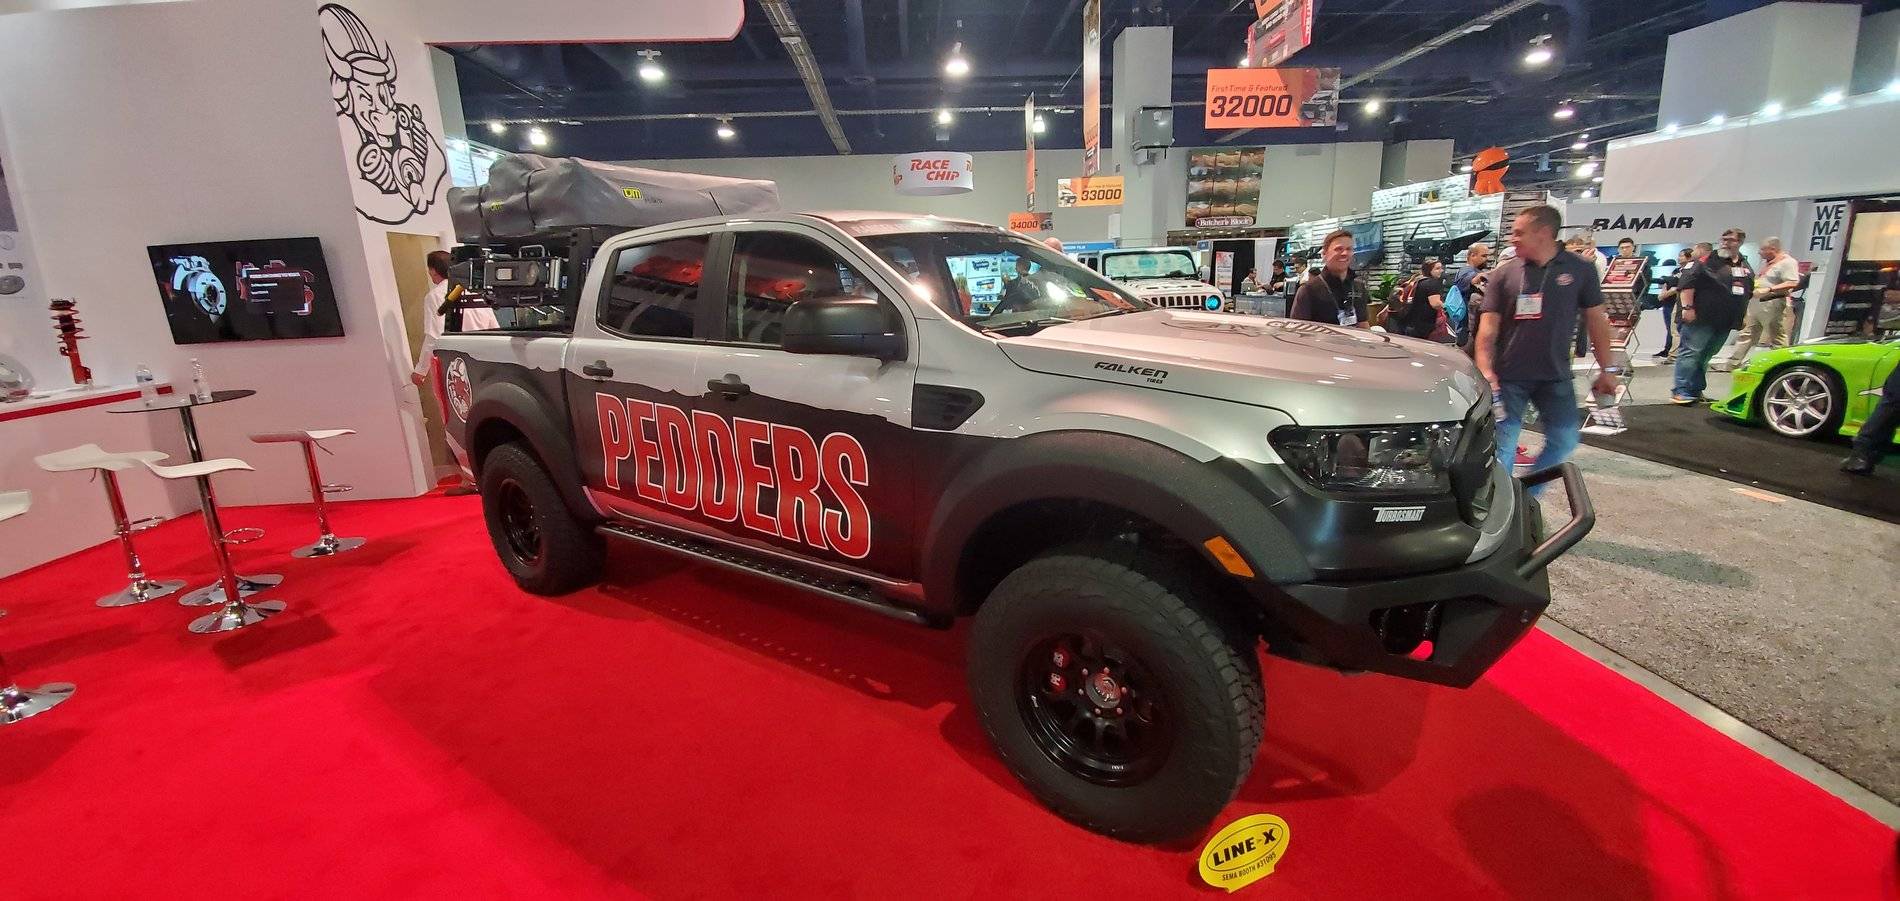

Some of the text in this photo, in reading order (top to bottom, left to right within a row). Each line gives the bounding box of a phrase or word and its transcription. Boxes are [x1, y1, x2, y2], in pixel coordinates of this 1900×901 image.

[1210, 95, 1293, 117] 32000
[911, 159, 950, 171] RACE
[926, 171, 959, 181] CHIP
[1081, 189, 1122, 201] 33000
[1816, 204, 1846, 220] WE
[1010, 221, 1038, 229] 34000
[1592, 213, 1694, 232] RAMAIR
[1094, 361, 1168, 378] FALKEN
[596, 392, 871, 559] PEDDERS
[1213, 829, 1276, 866] LINE-X
[1239, 866, 1256, 877] BOOTH
